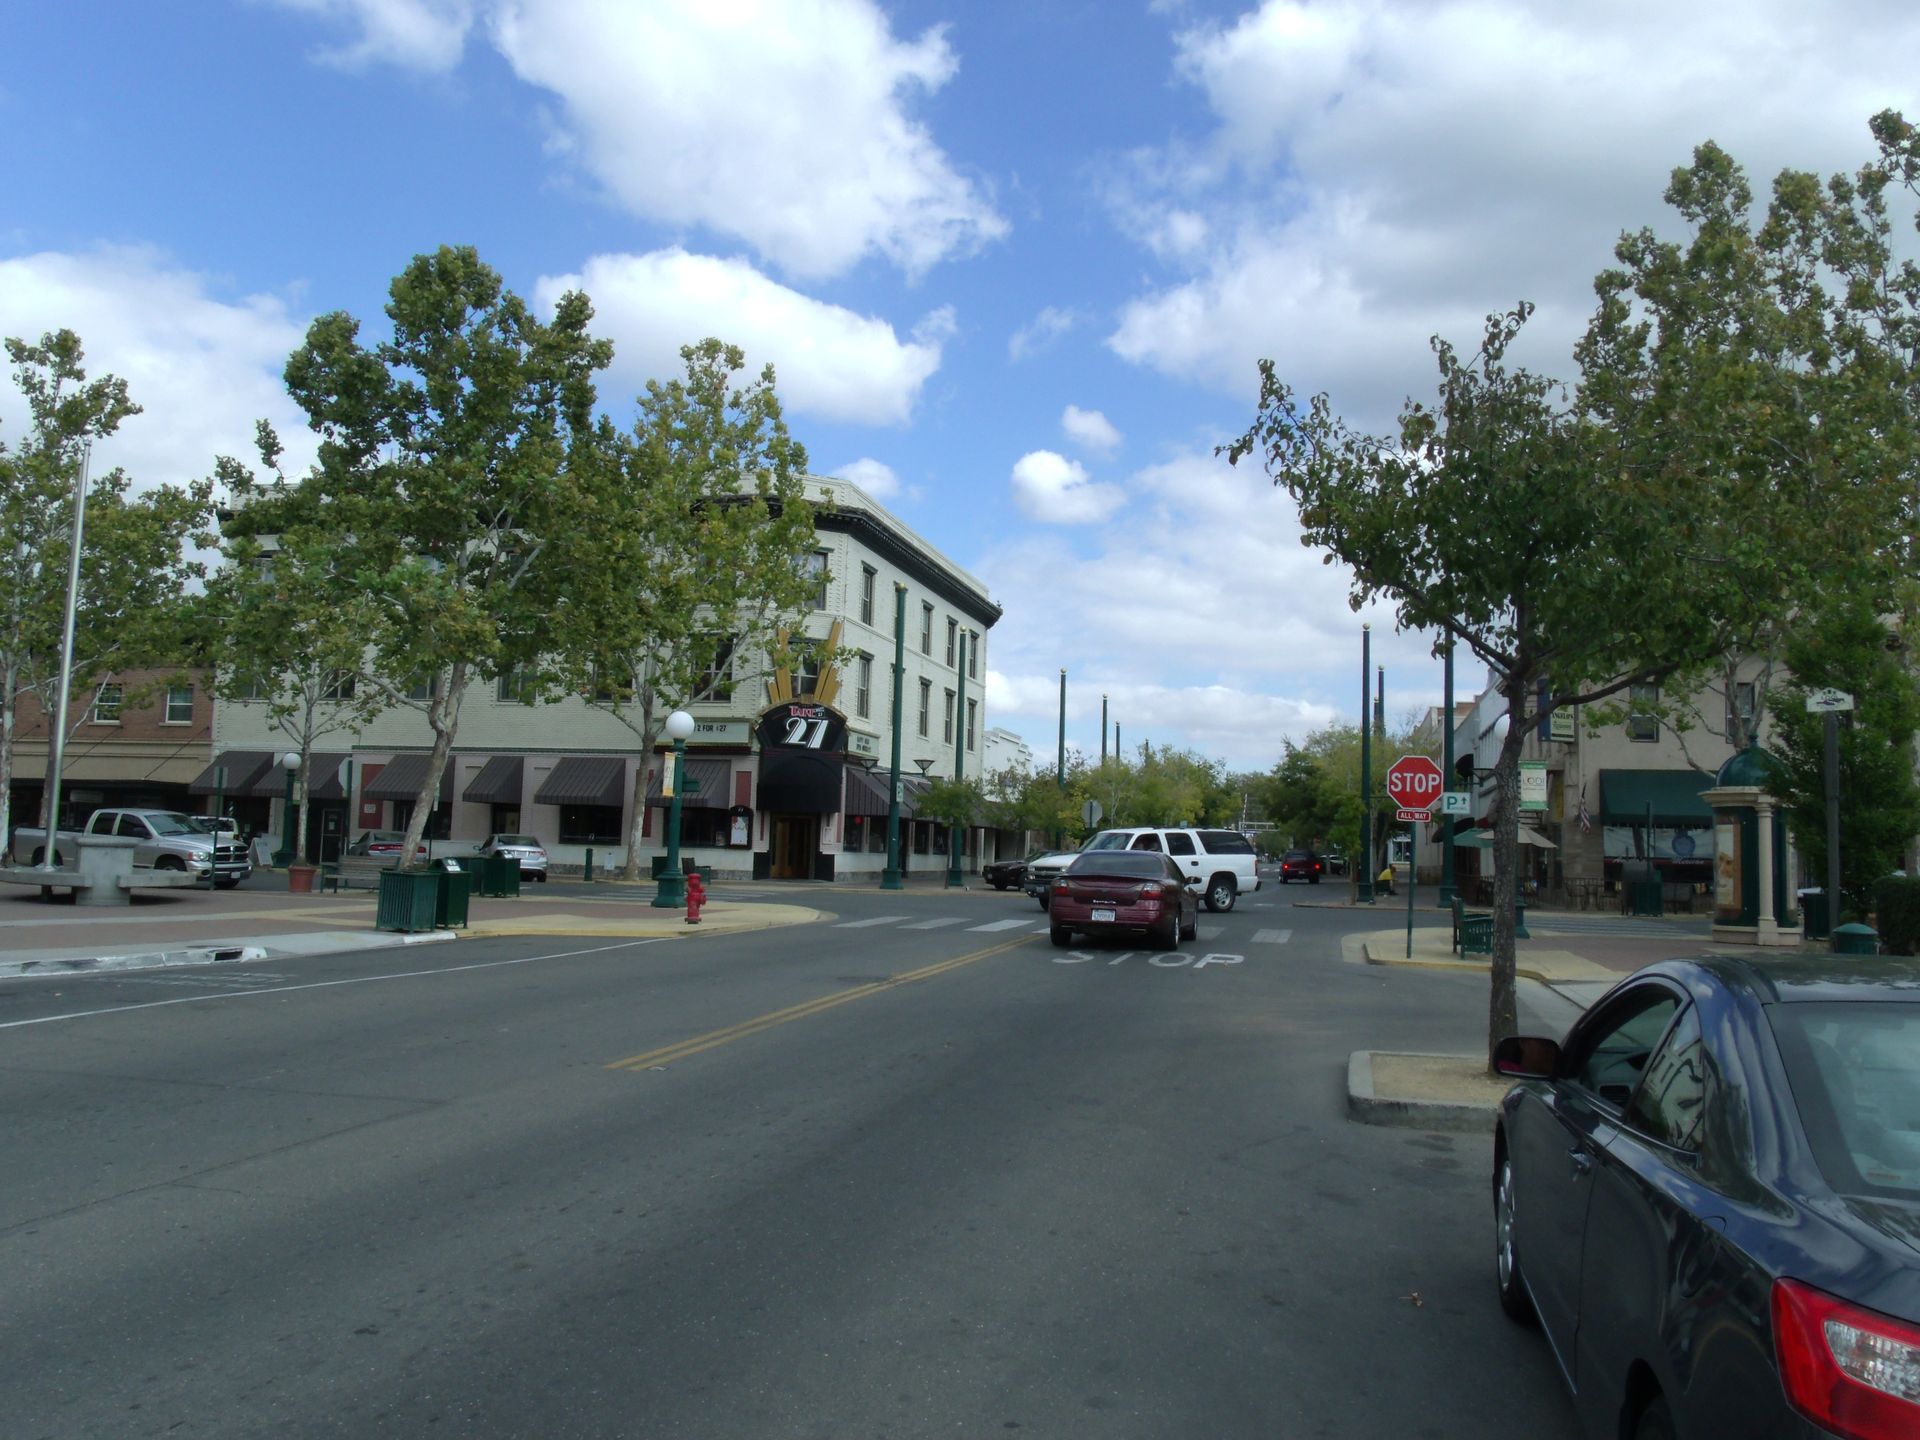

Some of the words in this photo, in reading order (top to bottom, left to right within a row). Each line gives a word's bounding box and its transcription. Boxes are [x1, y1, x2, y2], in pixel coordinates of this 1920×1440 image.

[702, 724, 714, 732] FOR
[785, 717, 829, 749] 27
[1390, 772, 1441, 793] STOP
[1446, 796, 1458, 810] P
[1414, 812, 1427, 820] WAY
